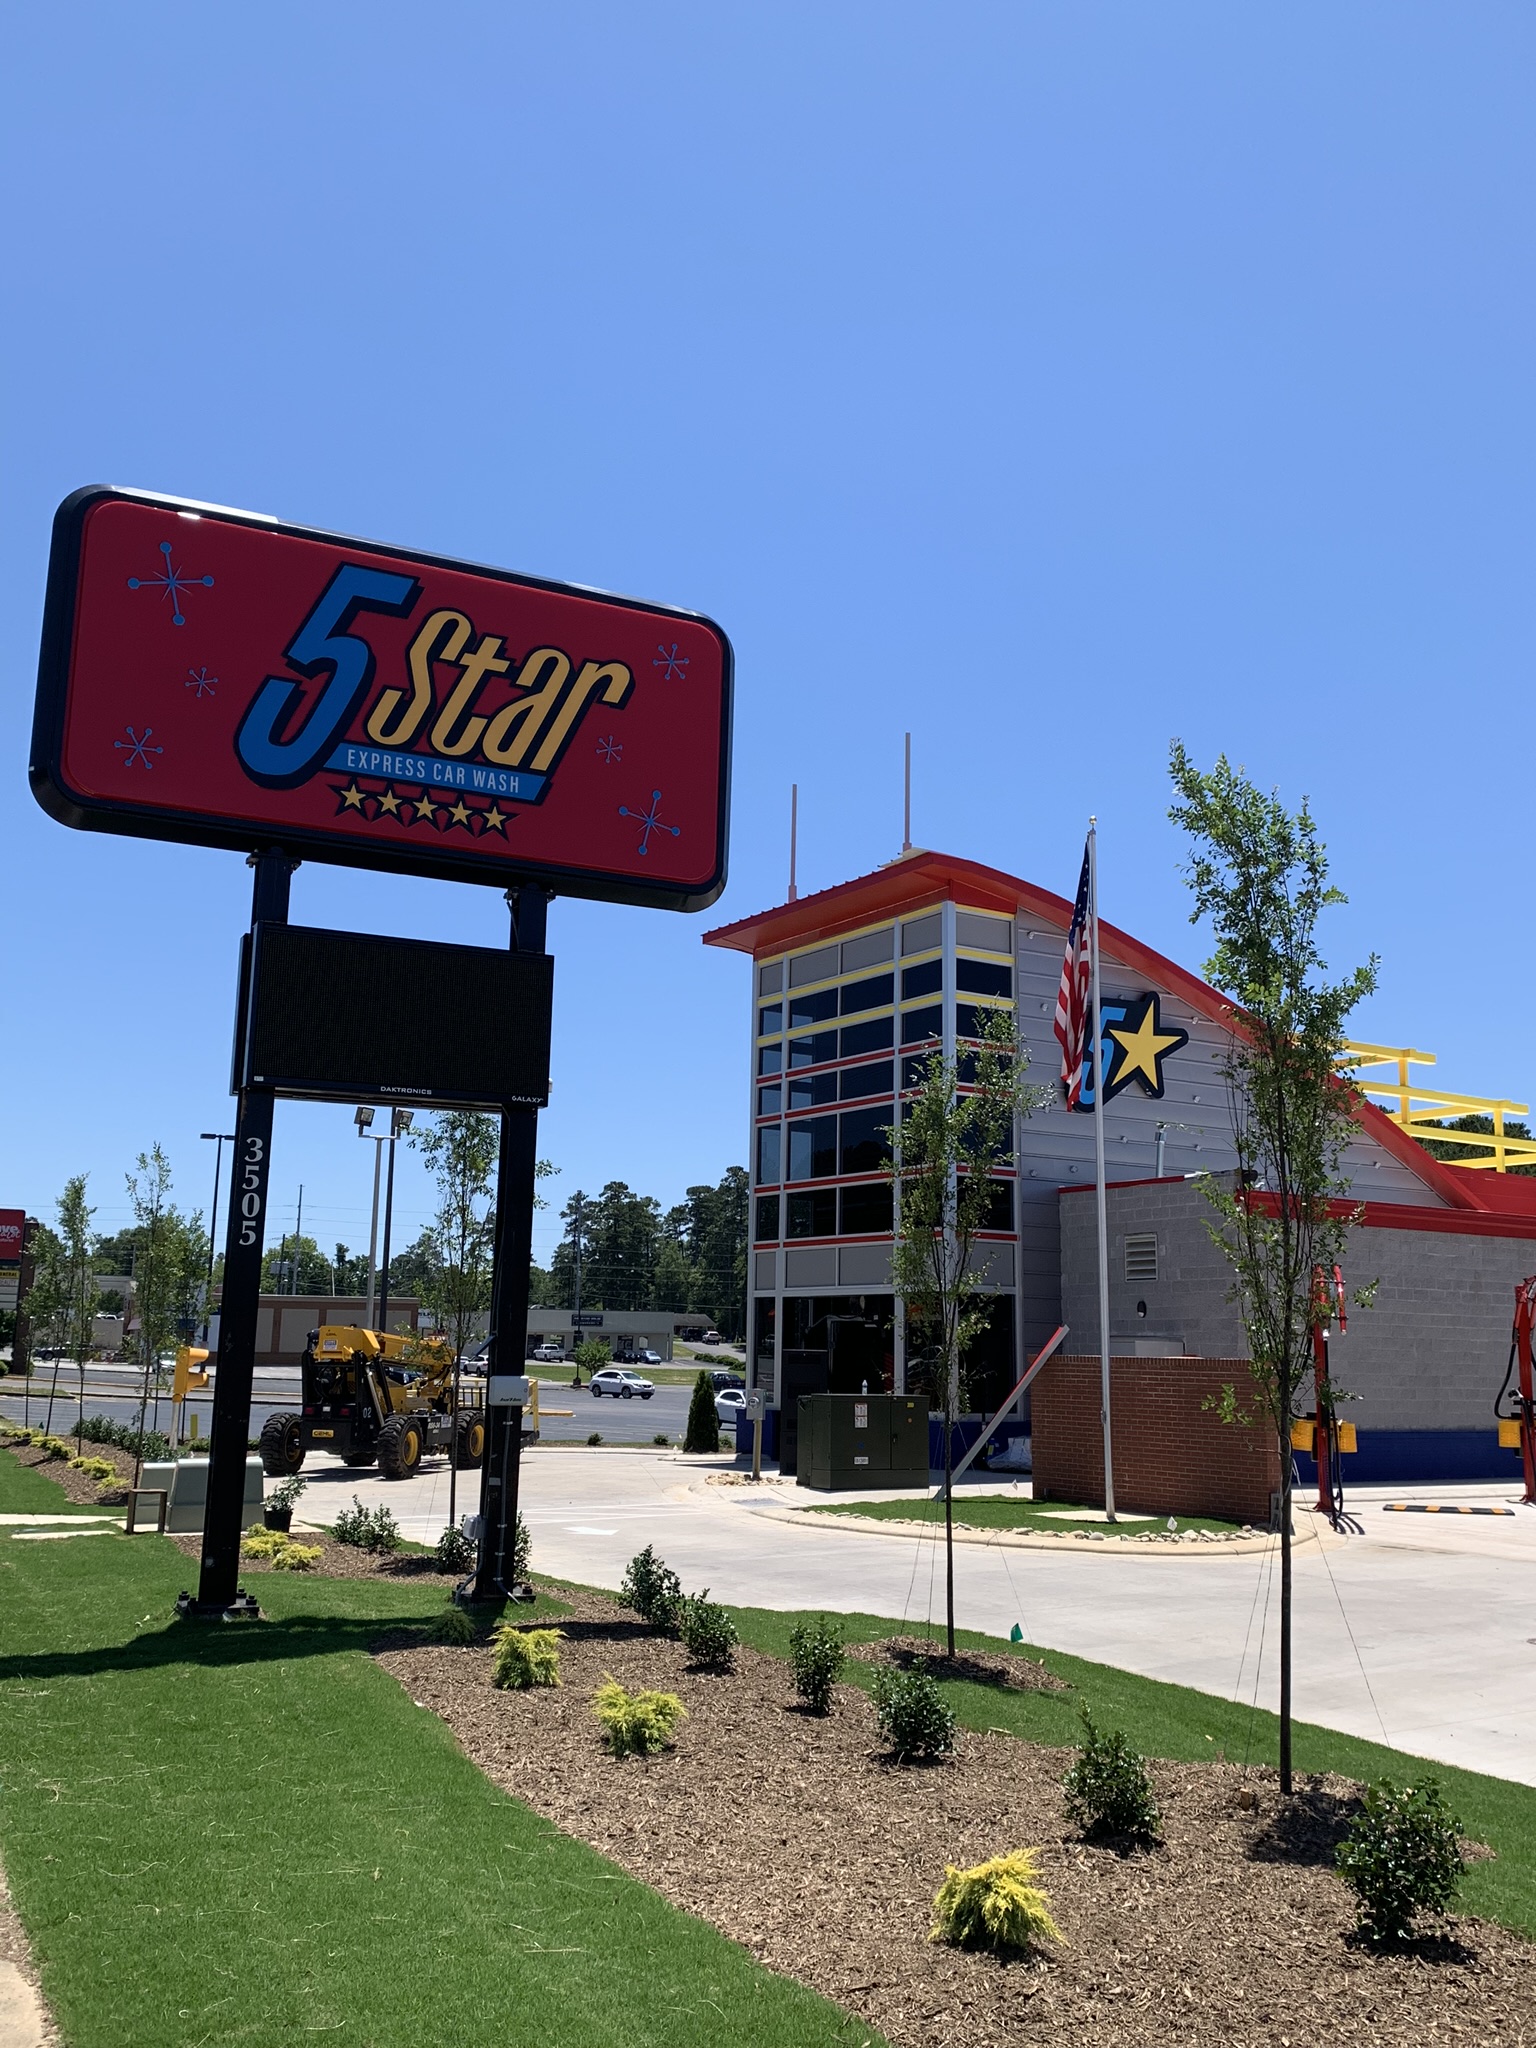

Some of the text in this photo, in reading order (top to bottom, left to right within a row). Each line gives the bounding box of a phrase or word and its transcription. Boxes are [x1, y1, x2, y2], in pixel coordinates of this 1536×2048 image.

[237, 564, 631, 777] 5 Star
[347, 750, 520, 794] EXPRESS CAR WASH
[1079, 1006, 1127, 1104] 5
[380, 1086, 432, 1095] DAKTRONICS
[511, 1095, 544, 1103] GALAXY
[238, 1137, 264, 1246] 3505
[362, 1407, 372, 1418] 02
